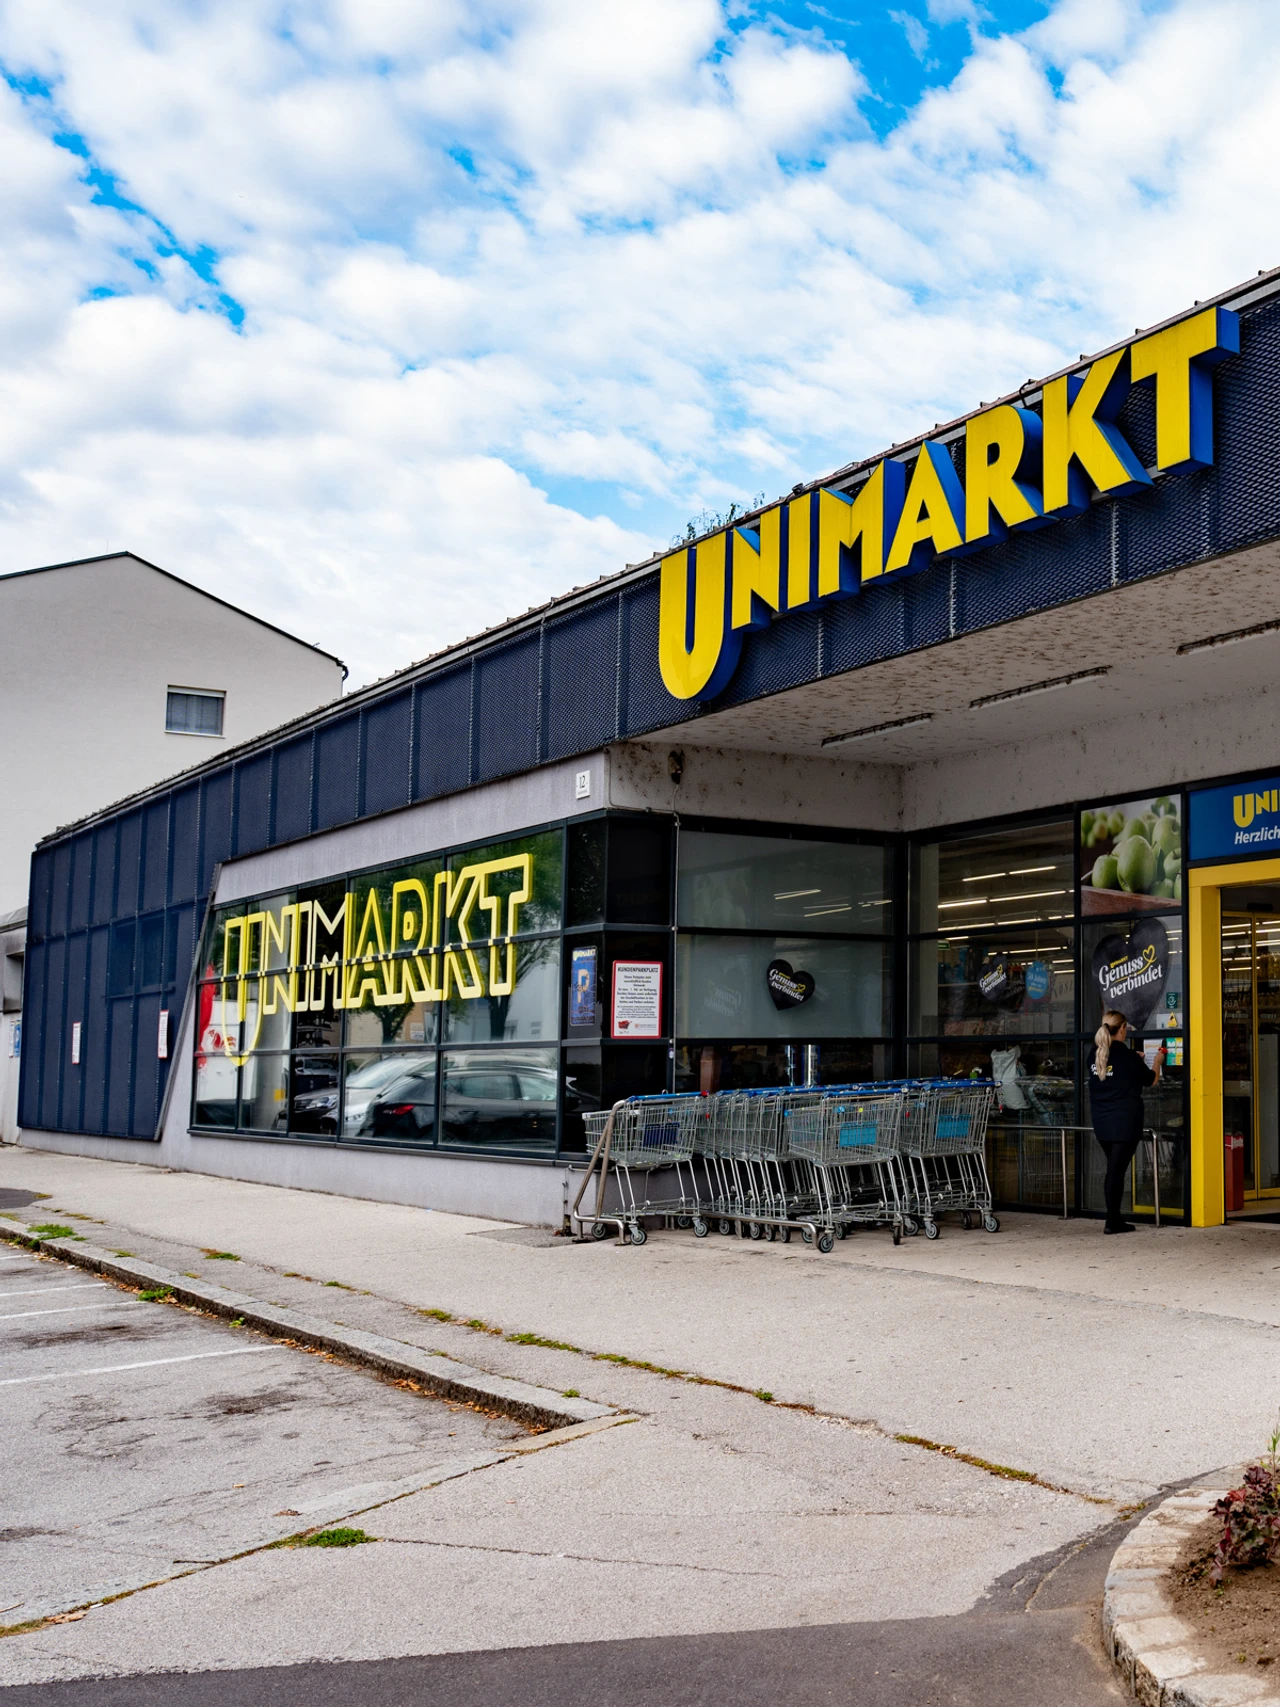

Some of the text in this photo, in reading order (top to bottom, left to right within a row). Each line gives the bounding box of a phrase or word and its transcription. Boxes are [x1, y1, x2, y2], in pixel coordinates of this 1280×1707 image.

[659, 305, 1239, 700] UNIMARKT
[579, 775, 586, 789] 12
[1234, 825, 1280, 844] Herzlich
[221, 853, 533, 1066] UNIMARKT
[1098, 956, 1144, 991] Genuss
[577, 968, 590, 1003] P
[769, 968, 798, 989] Genuss
[771, 980, 804, 1001] verbindet
[1110, 964, 1163, 998] verbindet
